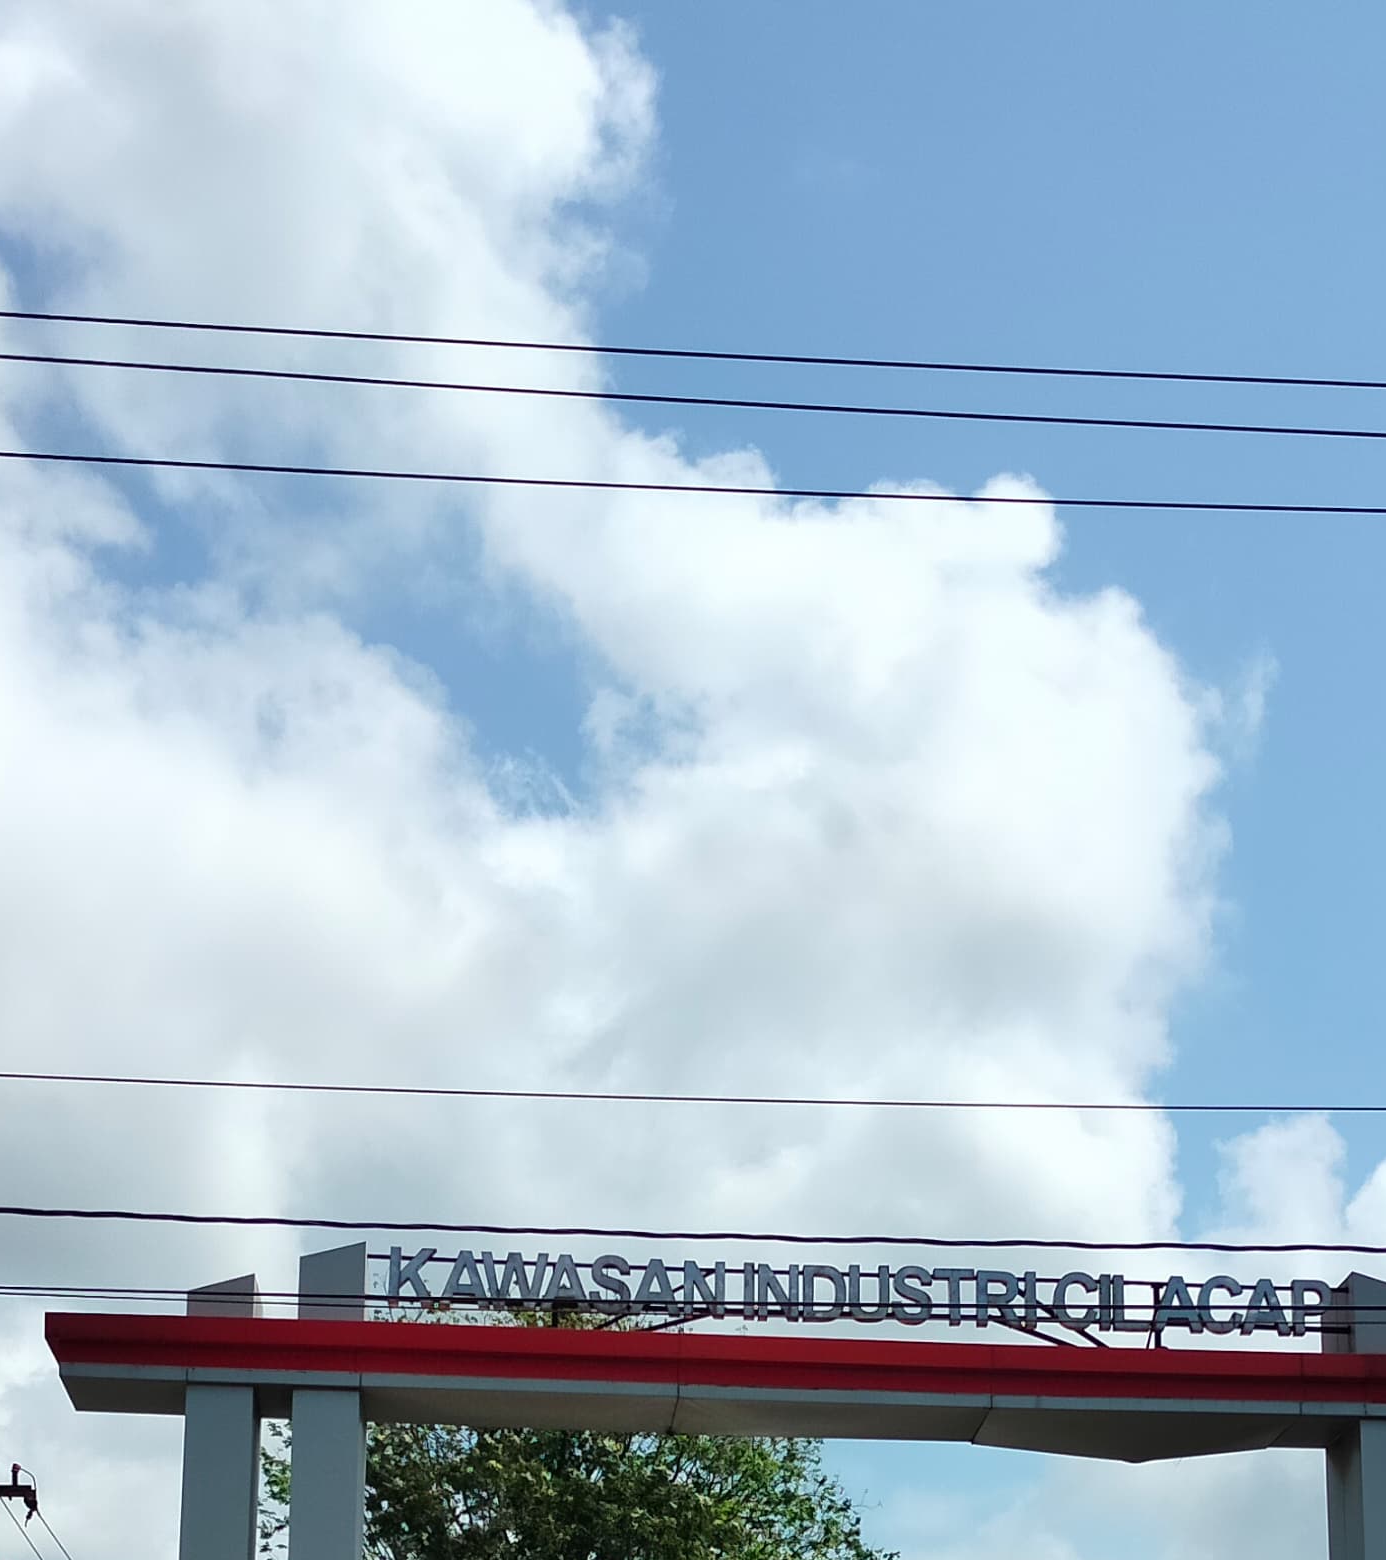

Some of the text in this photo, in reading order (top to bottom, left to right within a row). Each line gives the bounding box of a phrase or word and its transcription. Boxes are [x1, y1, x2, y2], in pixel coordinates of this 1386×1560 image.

[387, 1245, 1332, 1337] KAWASAN INDUSTRI CILACAP
